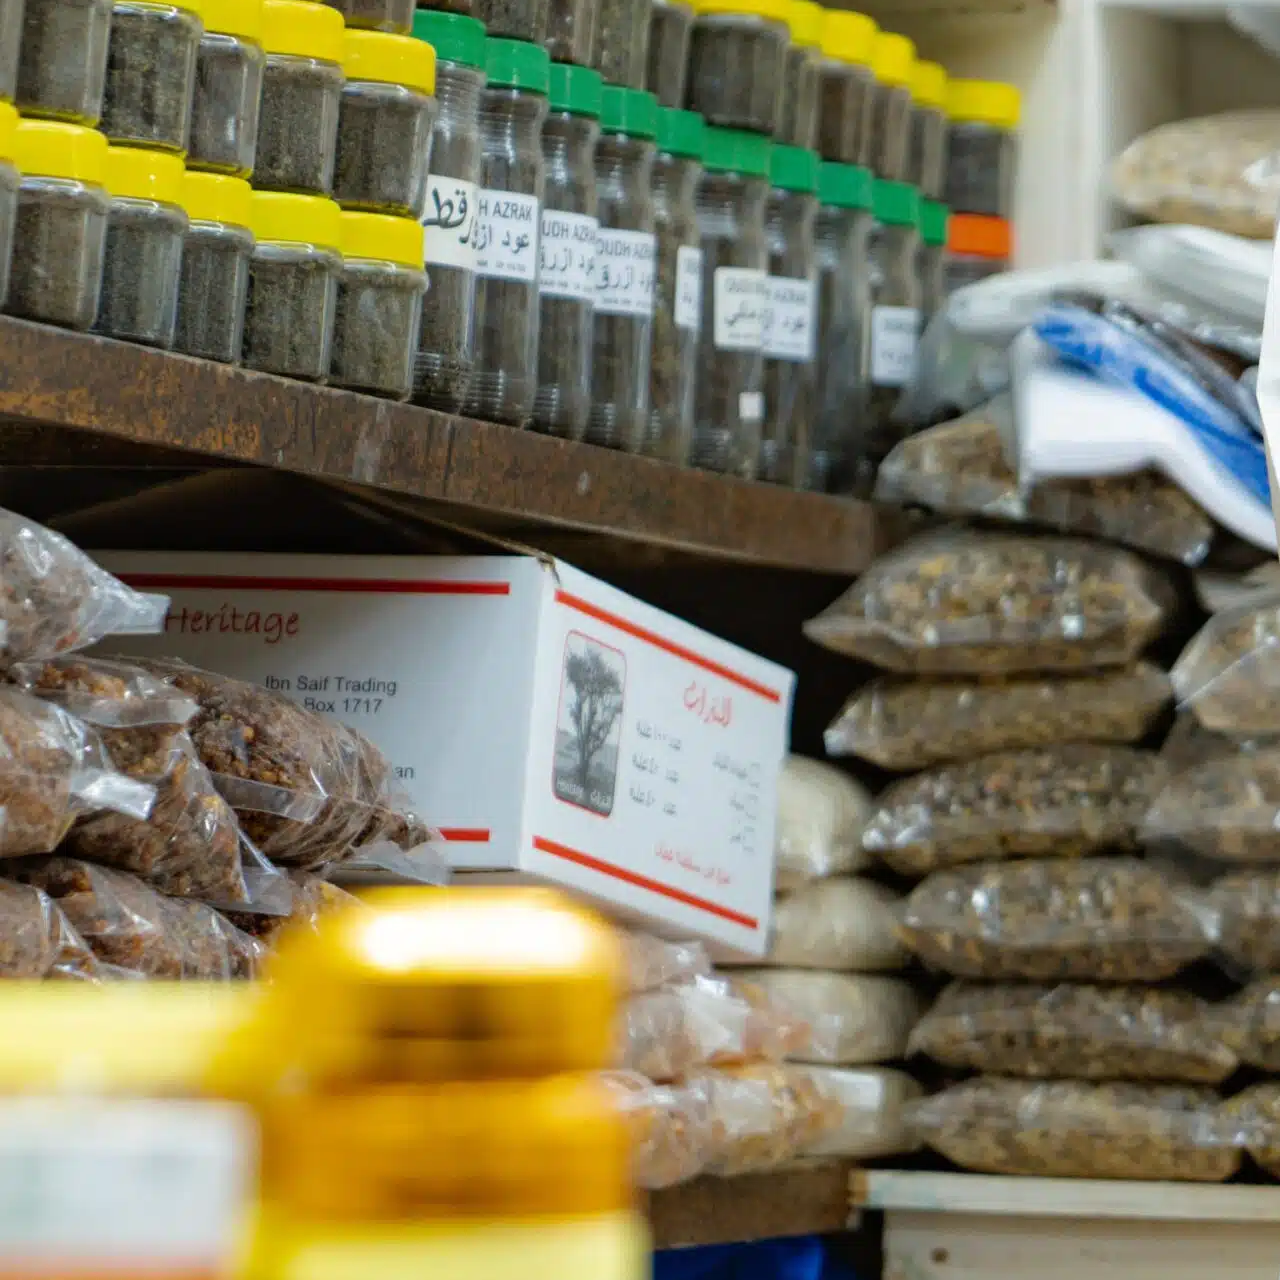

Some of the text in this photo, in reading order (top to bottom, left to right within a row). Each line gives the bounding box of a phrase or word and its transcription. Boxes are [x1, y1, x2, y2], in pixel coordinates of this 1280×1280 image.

[492, 201, 533, 222] AZRAK
[541, 220, 569, 239] UDH
[501, 230, 529, 254] عود
[163, 603, 300, 644] Heritage
[264, 675, 397, 697] Ibn Saif Trading
[303, 697, 383, 714] Box 1717
[394, 765, 415, 780] an
